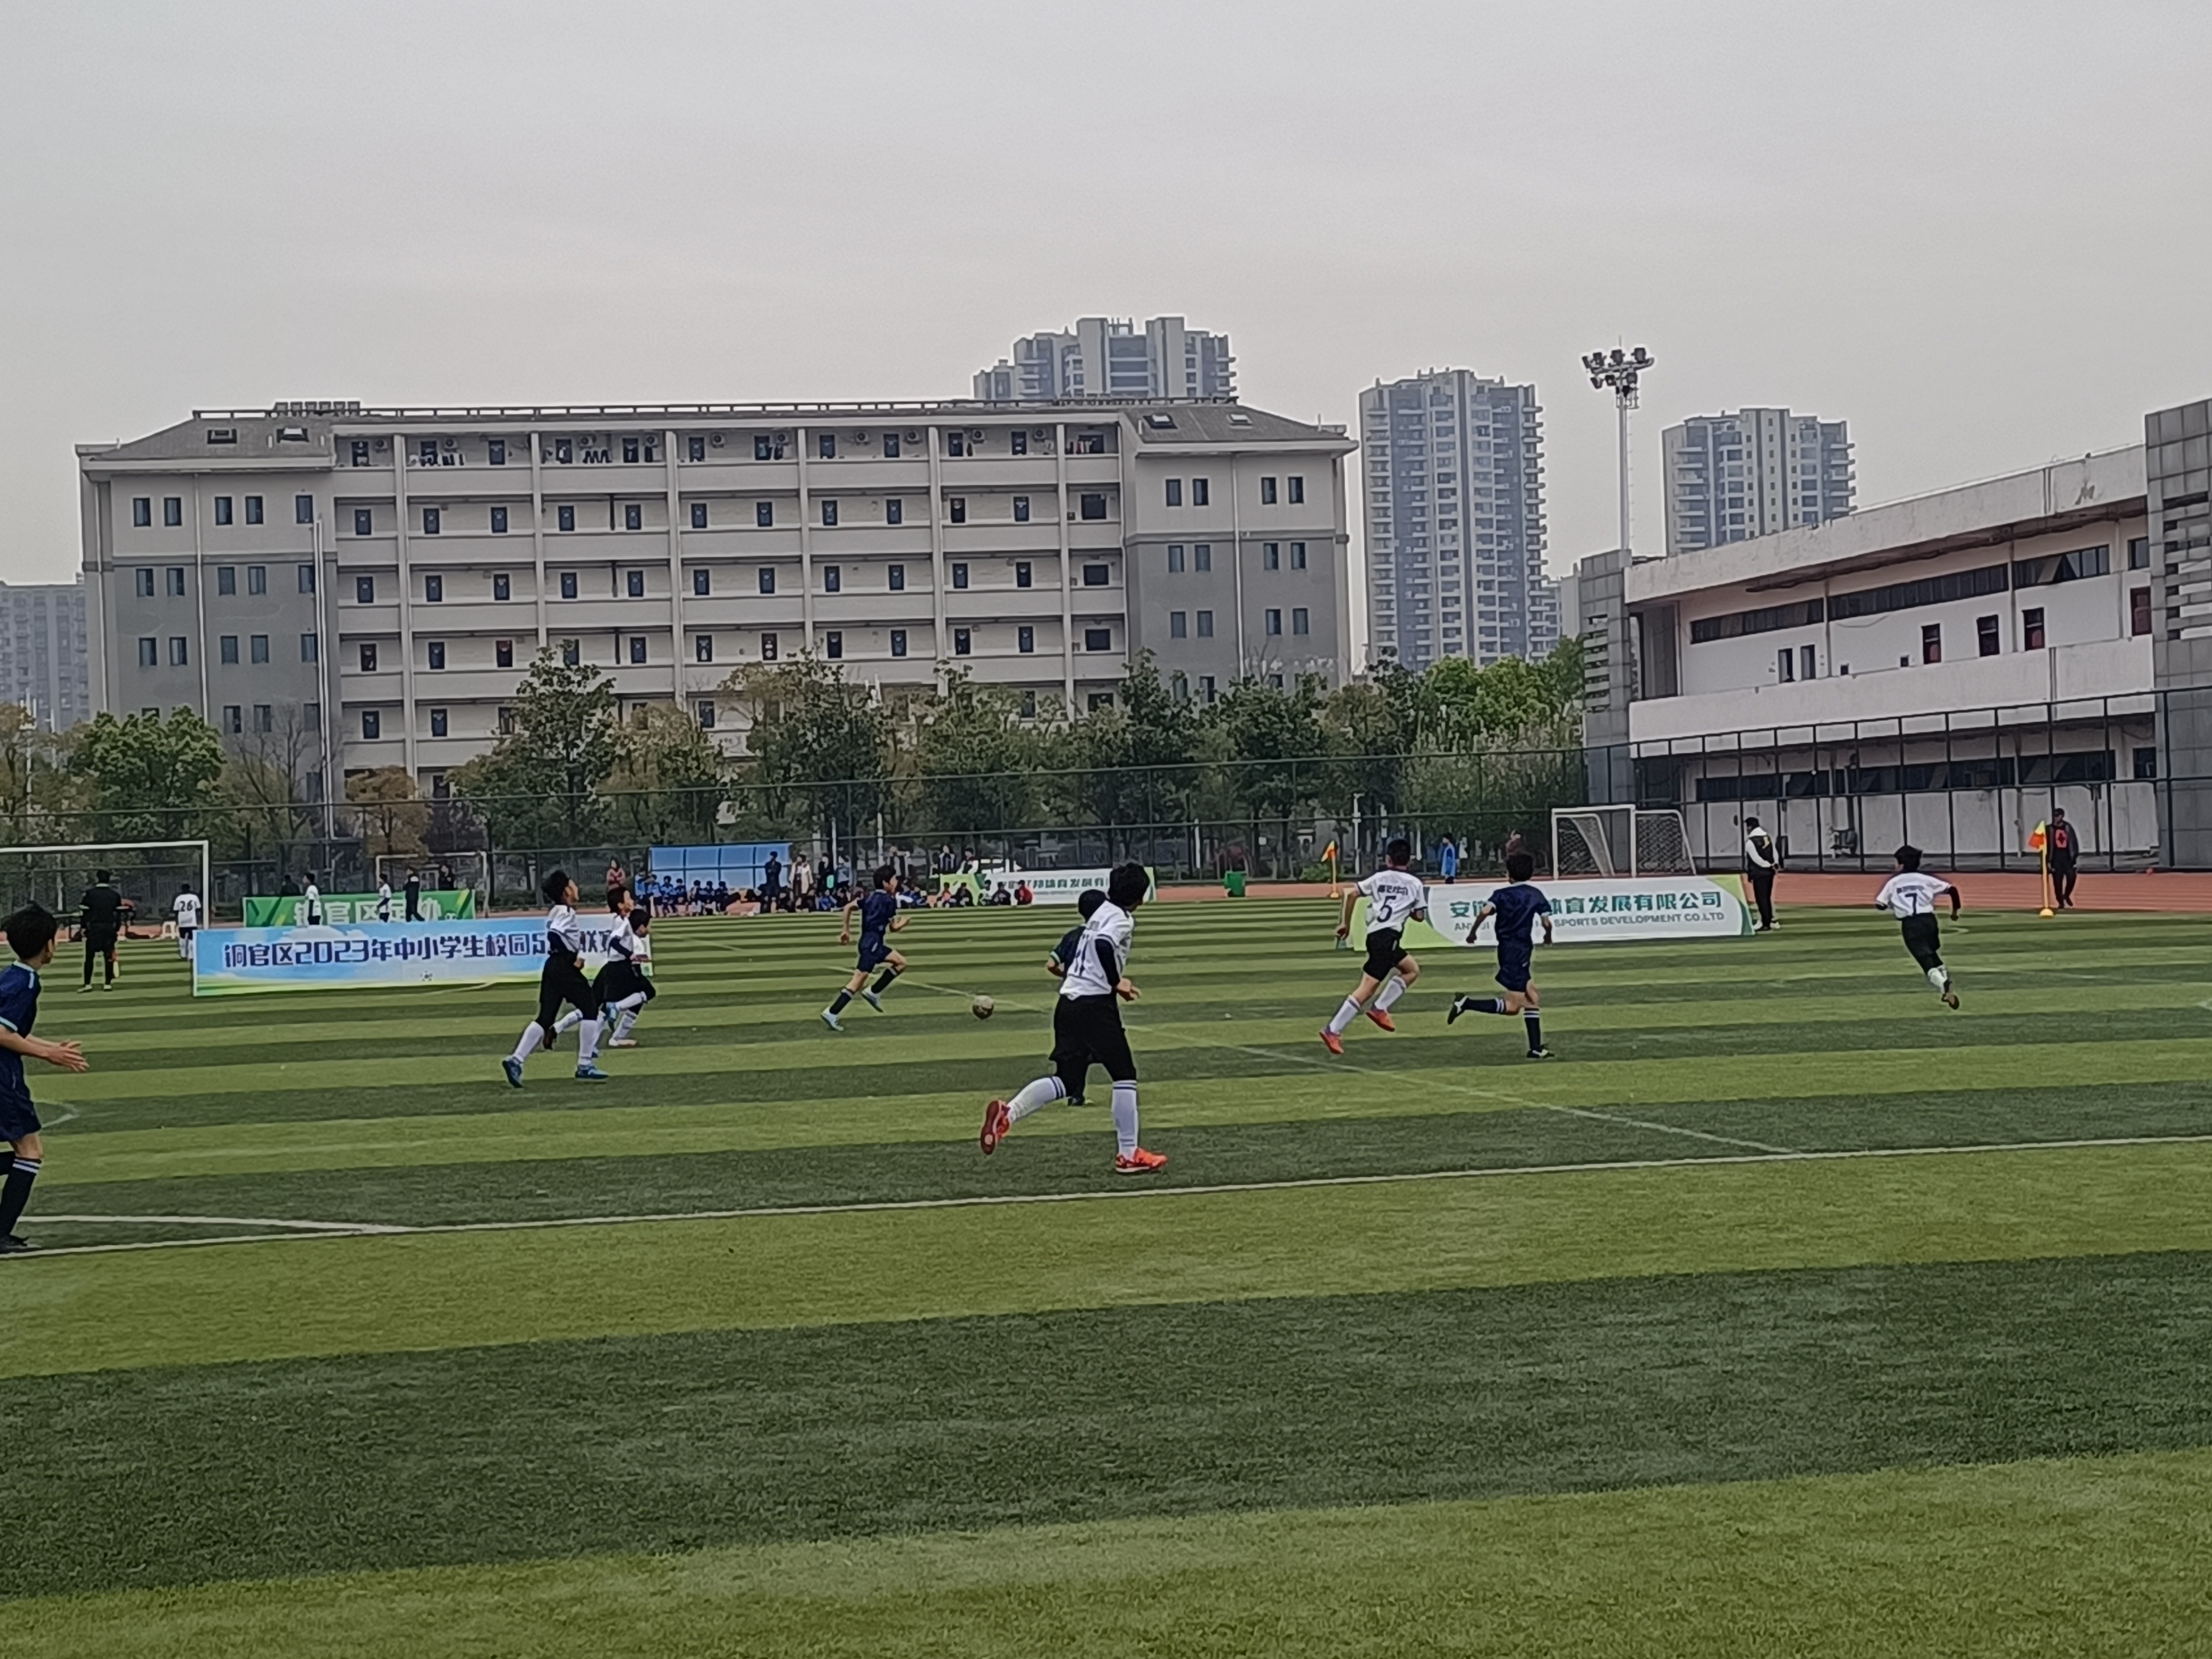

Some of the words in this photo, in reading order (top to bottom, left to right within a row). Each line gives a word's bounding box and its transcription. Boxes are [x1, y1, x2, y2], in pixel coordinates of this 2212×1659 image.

[179, 899, 193, 912] 26
[1377, 895, 1396, 922] 5
[1450, 891, 1722, 918] 安体育发展有限公司
[1904, 893, 1918, 915] 7
[1554, 917, 1599, 927] SPORTS
[1600, 914, 1682, 925] DEVELOPMENT
